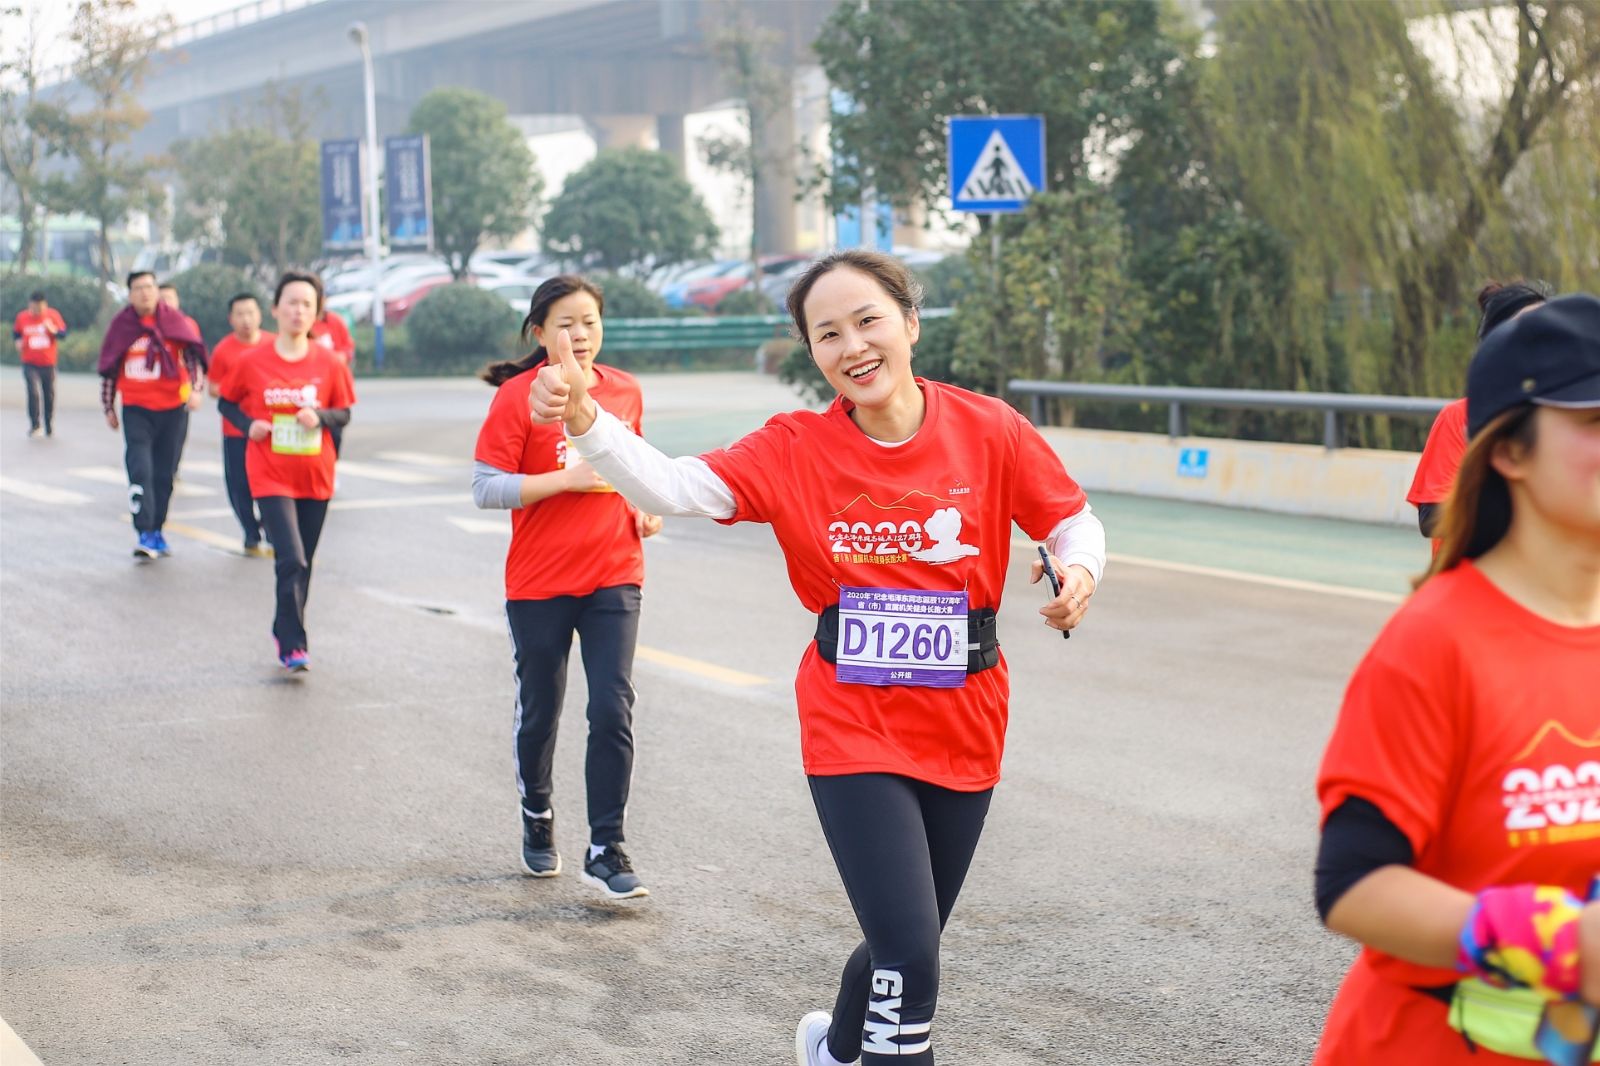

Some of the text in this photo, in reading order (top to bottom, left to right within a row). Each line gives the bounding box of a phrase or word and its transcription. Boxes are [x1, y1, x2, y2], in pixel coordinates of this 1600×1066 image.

[828, 520, 923, 555] 2020
[843, 618, 953, 661] D1260
[890, 671, 912, 680] 公开组
[862, 969, 903, 1055] GYM
